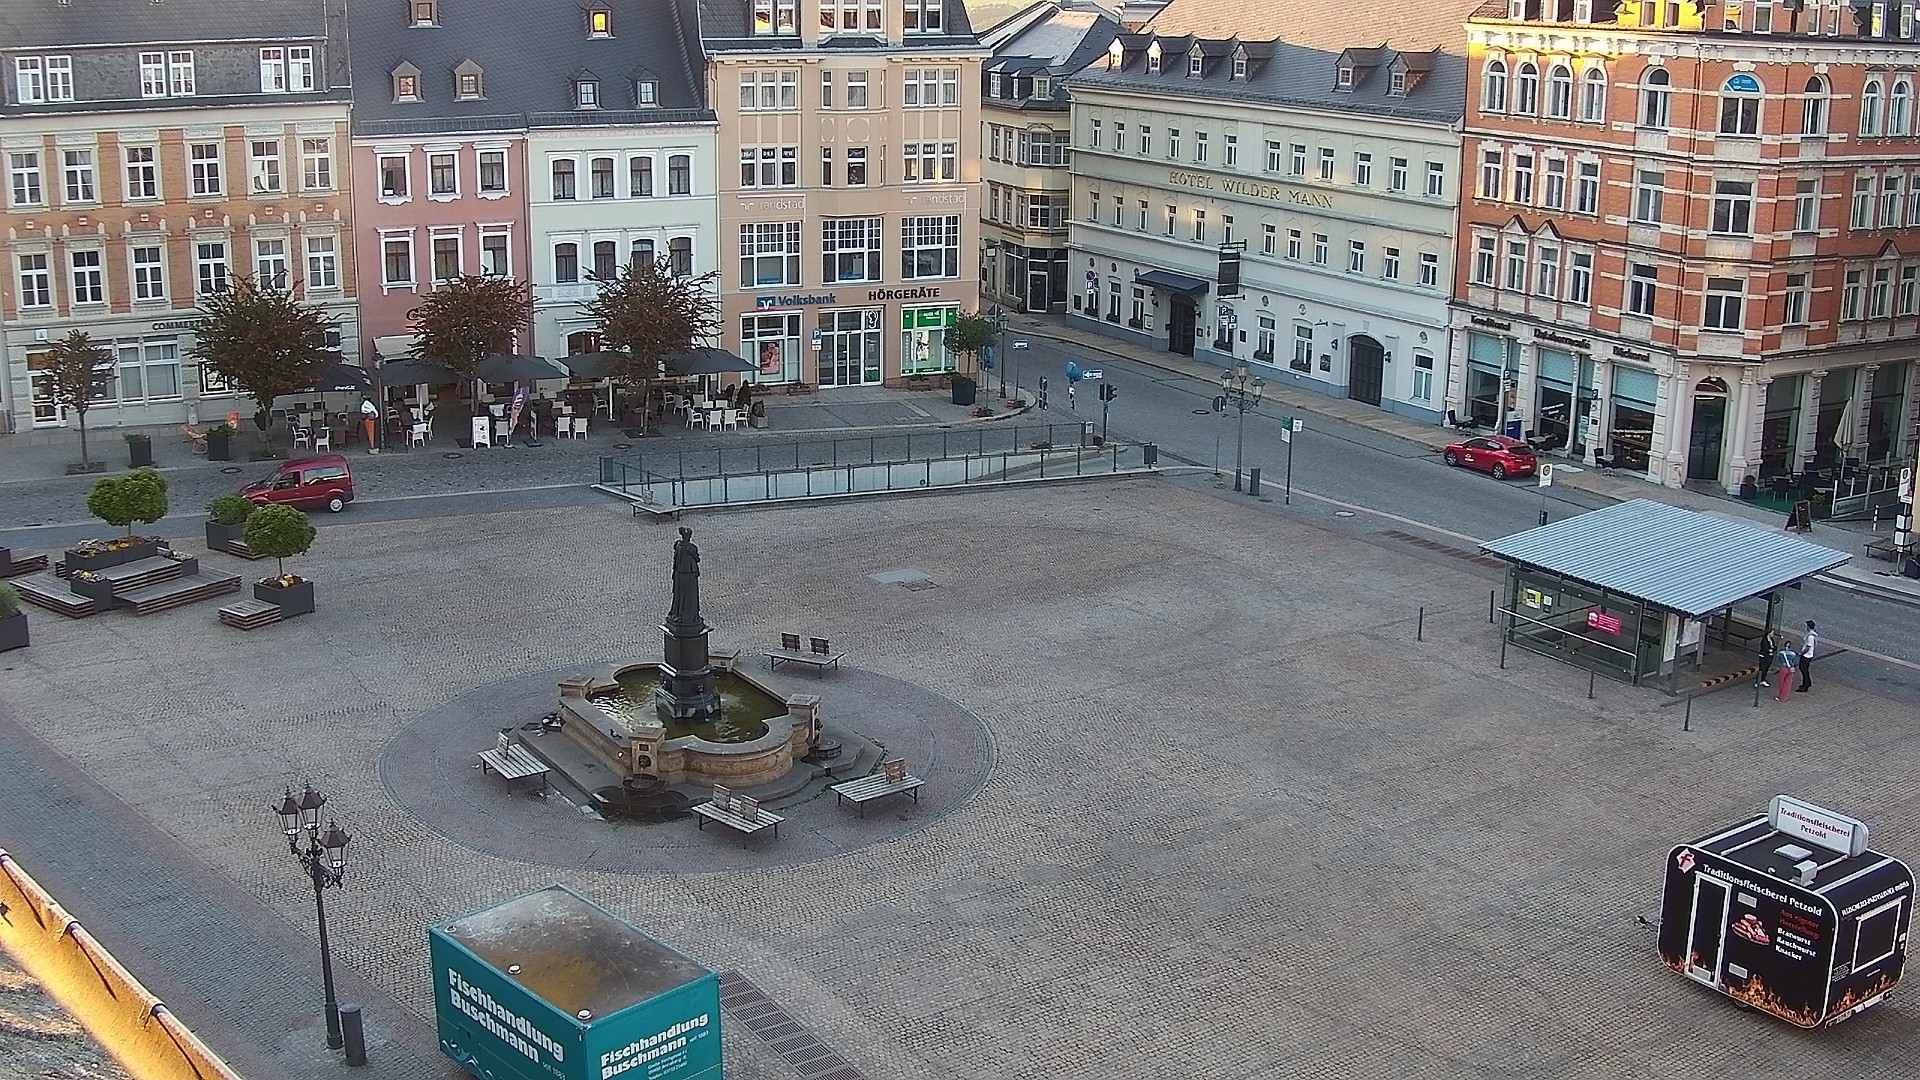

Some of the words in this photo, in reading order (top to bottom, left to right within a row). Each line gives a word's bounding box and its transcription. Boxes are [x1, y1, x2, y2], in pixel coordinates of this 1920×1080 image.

[759, 199, 805, 210] randstad
[1169, 170, 1213, 190] HOTEL
[1222, 178, 1280, 200] WILDER
[1288, 189, 1334, 208] MANN
[778, 293, 836, 306] Volksbank
[868, 286, 940, 301] HÖRGERÄTE
[1780, 807, 1850, 837] Traditionsfleischerei
[1800, 824, 1827, 839] Petzold
[1703, 863, 1788, 903] Traditionsfleischerei
[1789, 897, 1822, 917] Petzold
[1777, 927, 1811, 945] Bratwurst
[448, 967, 564, 1062] Fischhandlung
[450, 988, 540, 1064] Buschmann
[600, 1013, 709, 1067] Fischhandlung
[601, 1036, 687, 1080] Buschmann
